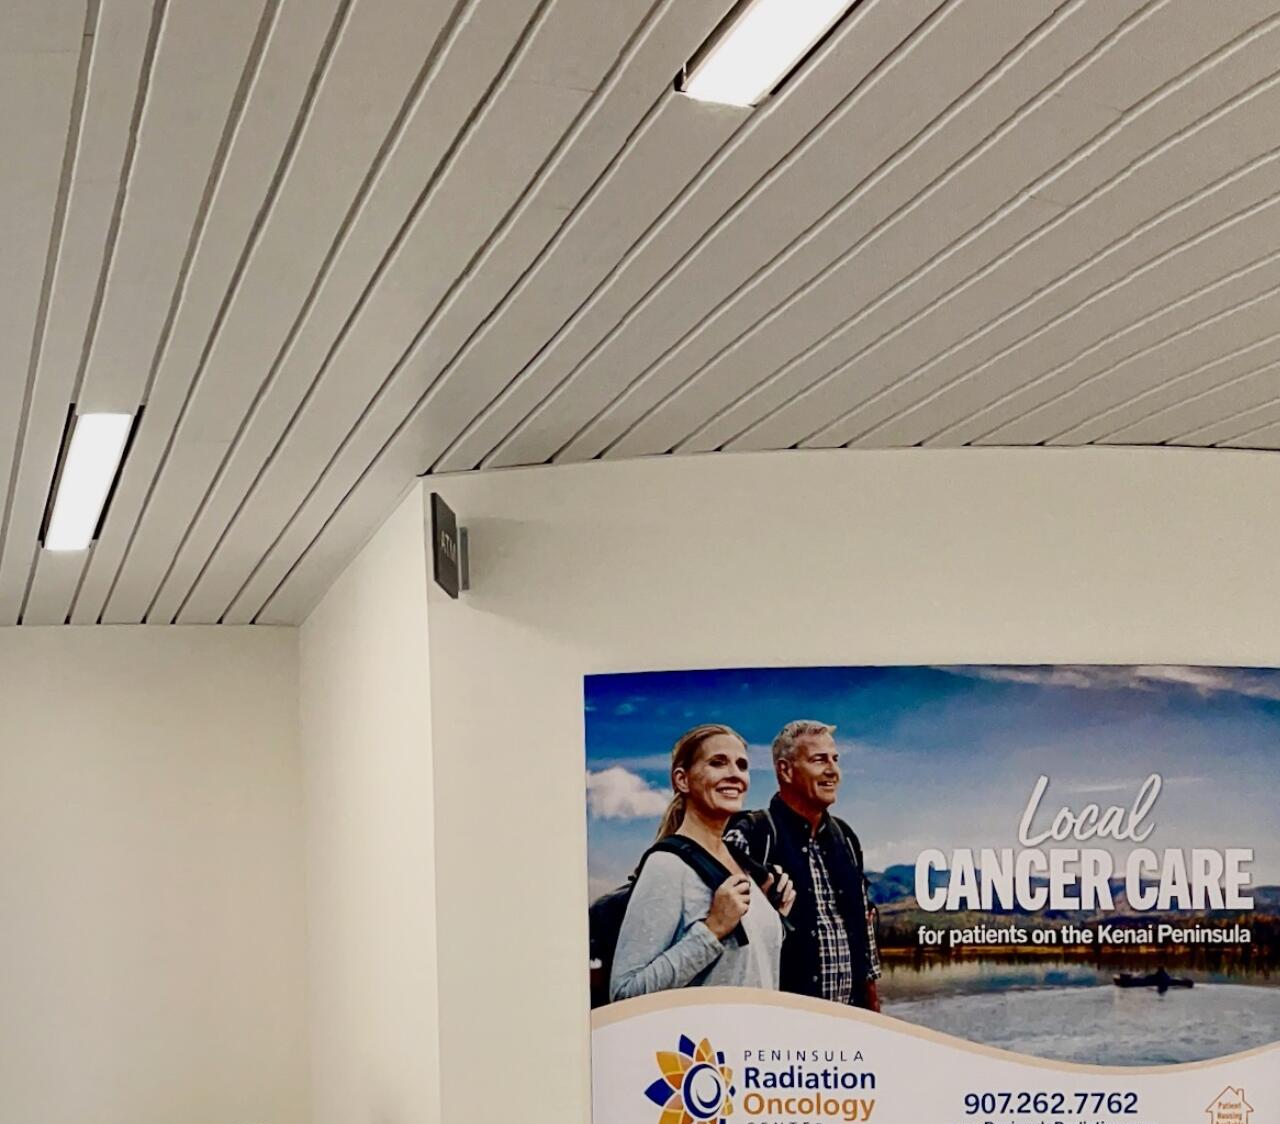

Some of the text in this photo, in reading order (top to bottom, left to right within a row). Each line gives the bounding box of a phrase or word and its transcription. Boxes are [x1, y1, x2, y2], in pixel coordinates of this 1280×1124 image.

[1018, 773, 1163, 847] Local
[914, 848, 1255, 912] CANCER CARE
[918, 924, 1251, 947] for patients on the Kenai Peninsula
[744, 1050, 864, 1062] PENINSULA
[744, 1065, 876, 1089] Radiation
[743, 1092, 876, 1122] Oncology
[964, 1092, 1138, 1115] 907.262.7762
